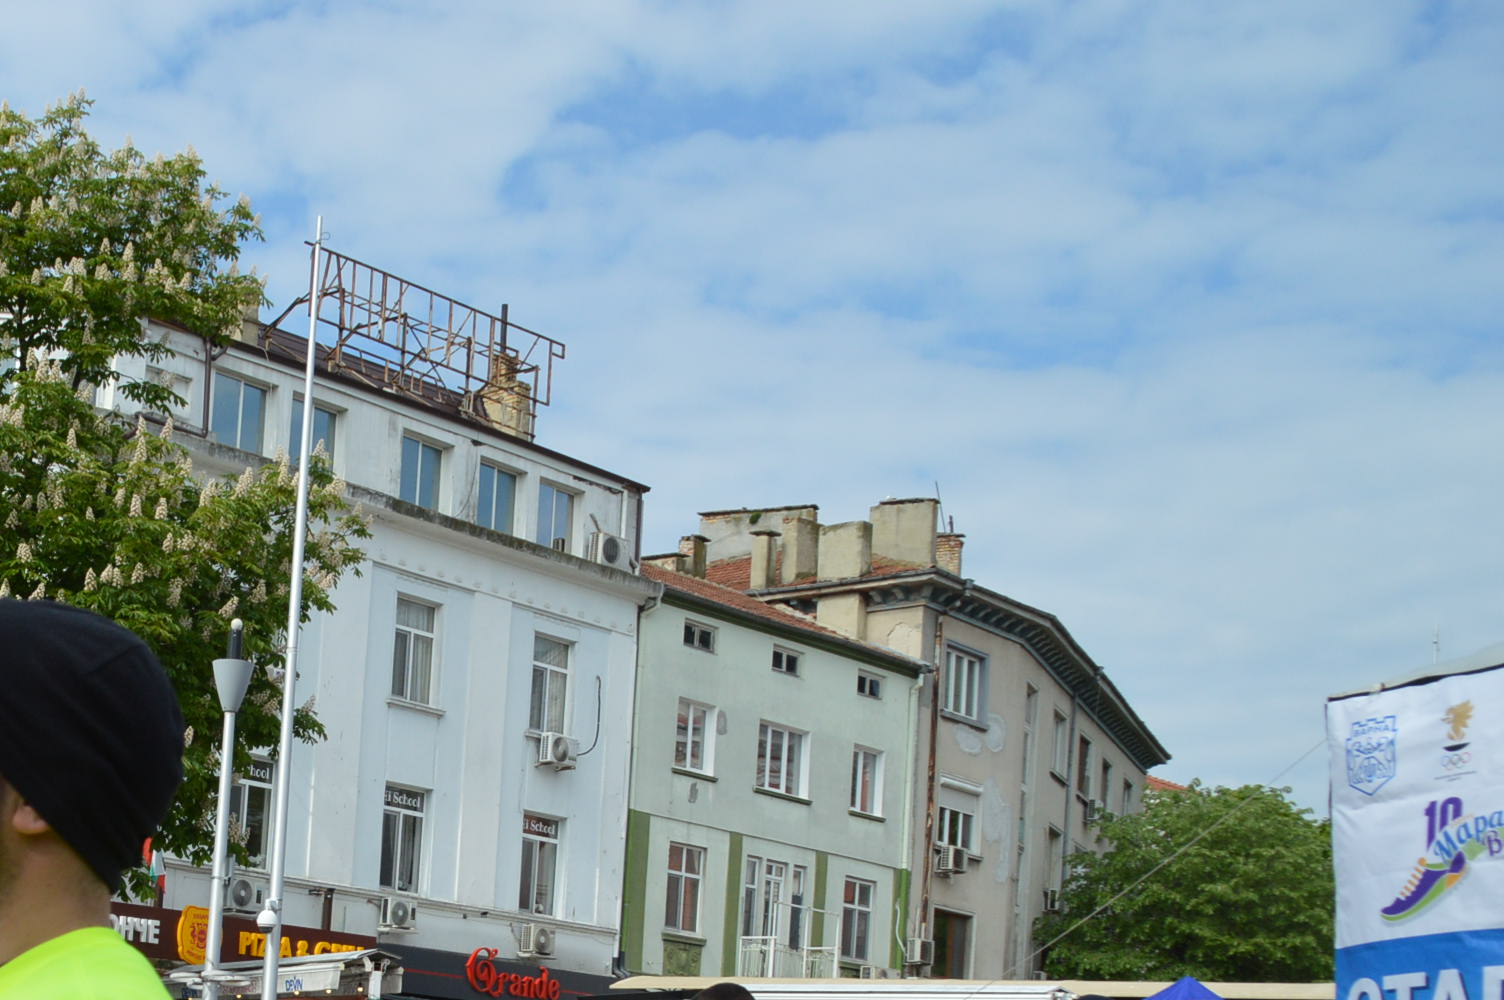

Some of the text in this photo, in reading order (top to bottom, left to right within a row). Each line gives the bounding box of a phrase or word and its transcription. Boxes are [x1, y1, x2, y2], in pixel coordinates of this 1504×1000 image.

[1433, 809, 1504, 861] Мара
[238, 931, 292, 958] PIZA
[284, 977, 303, 992] DEVIN
[465, 946, 561, 1000] Grande
